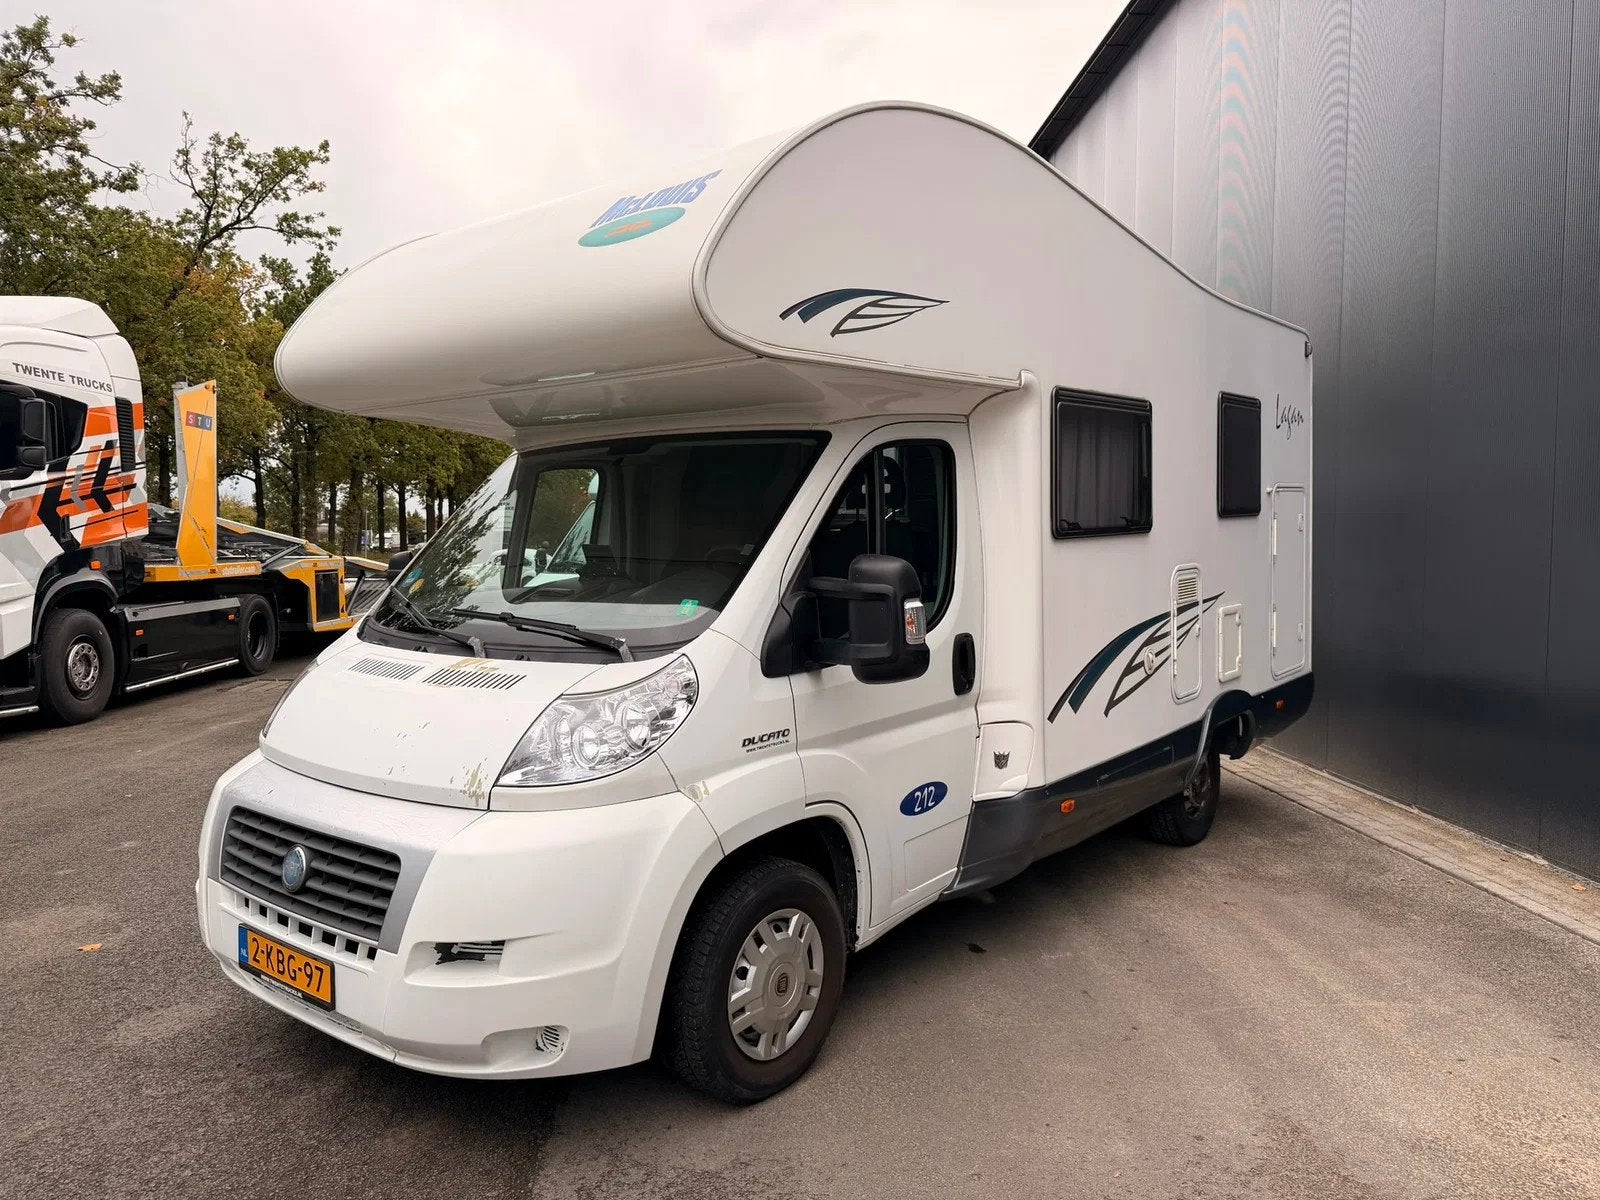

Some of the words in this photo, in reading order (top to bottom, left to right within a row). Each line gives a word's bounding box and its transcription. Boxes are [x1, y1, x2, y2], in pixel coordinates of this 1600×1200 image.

[12, 362, 65, 382] TWENTE
[69, 374, 112, 393] TRUCKS
[741, 728, 790, 748] DUCATO
[914, 786, 935, 812] 212
[252, 937, 324, 993] 2-KBG-97
